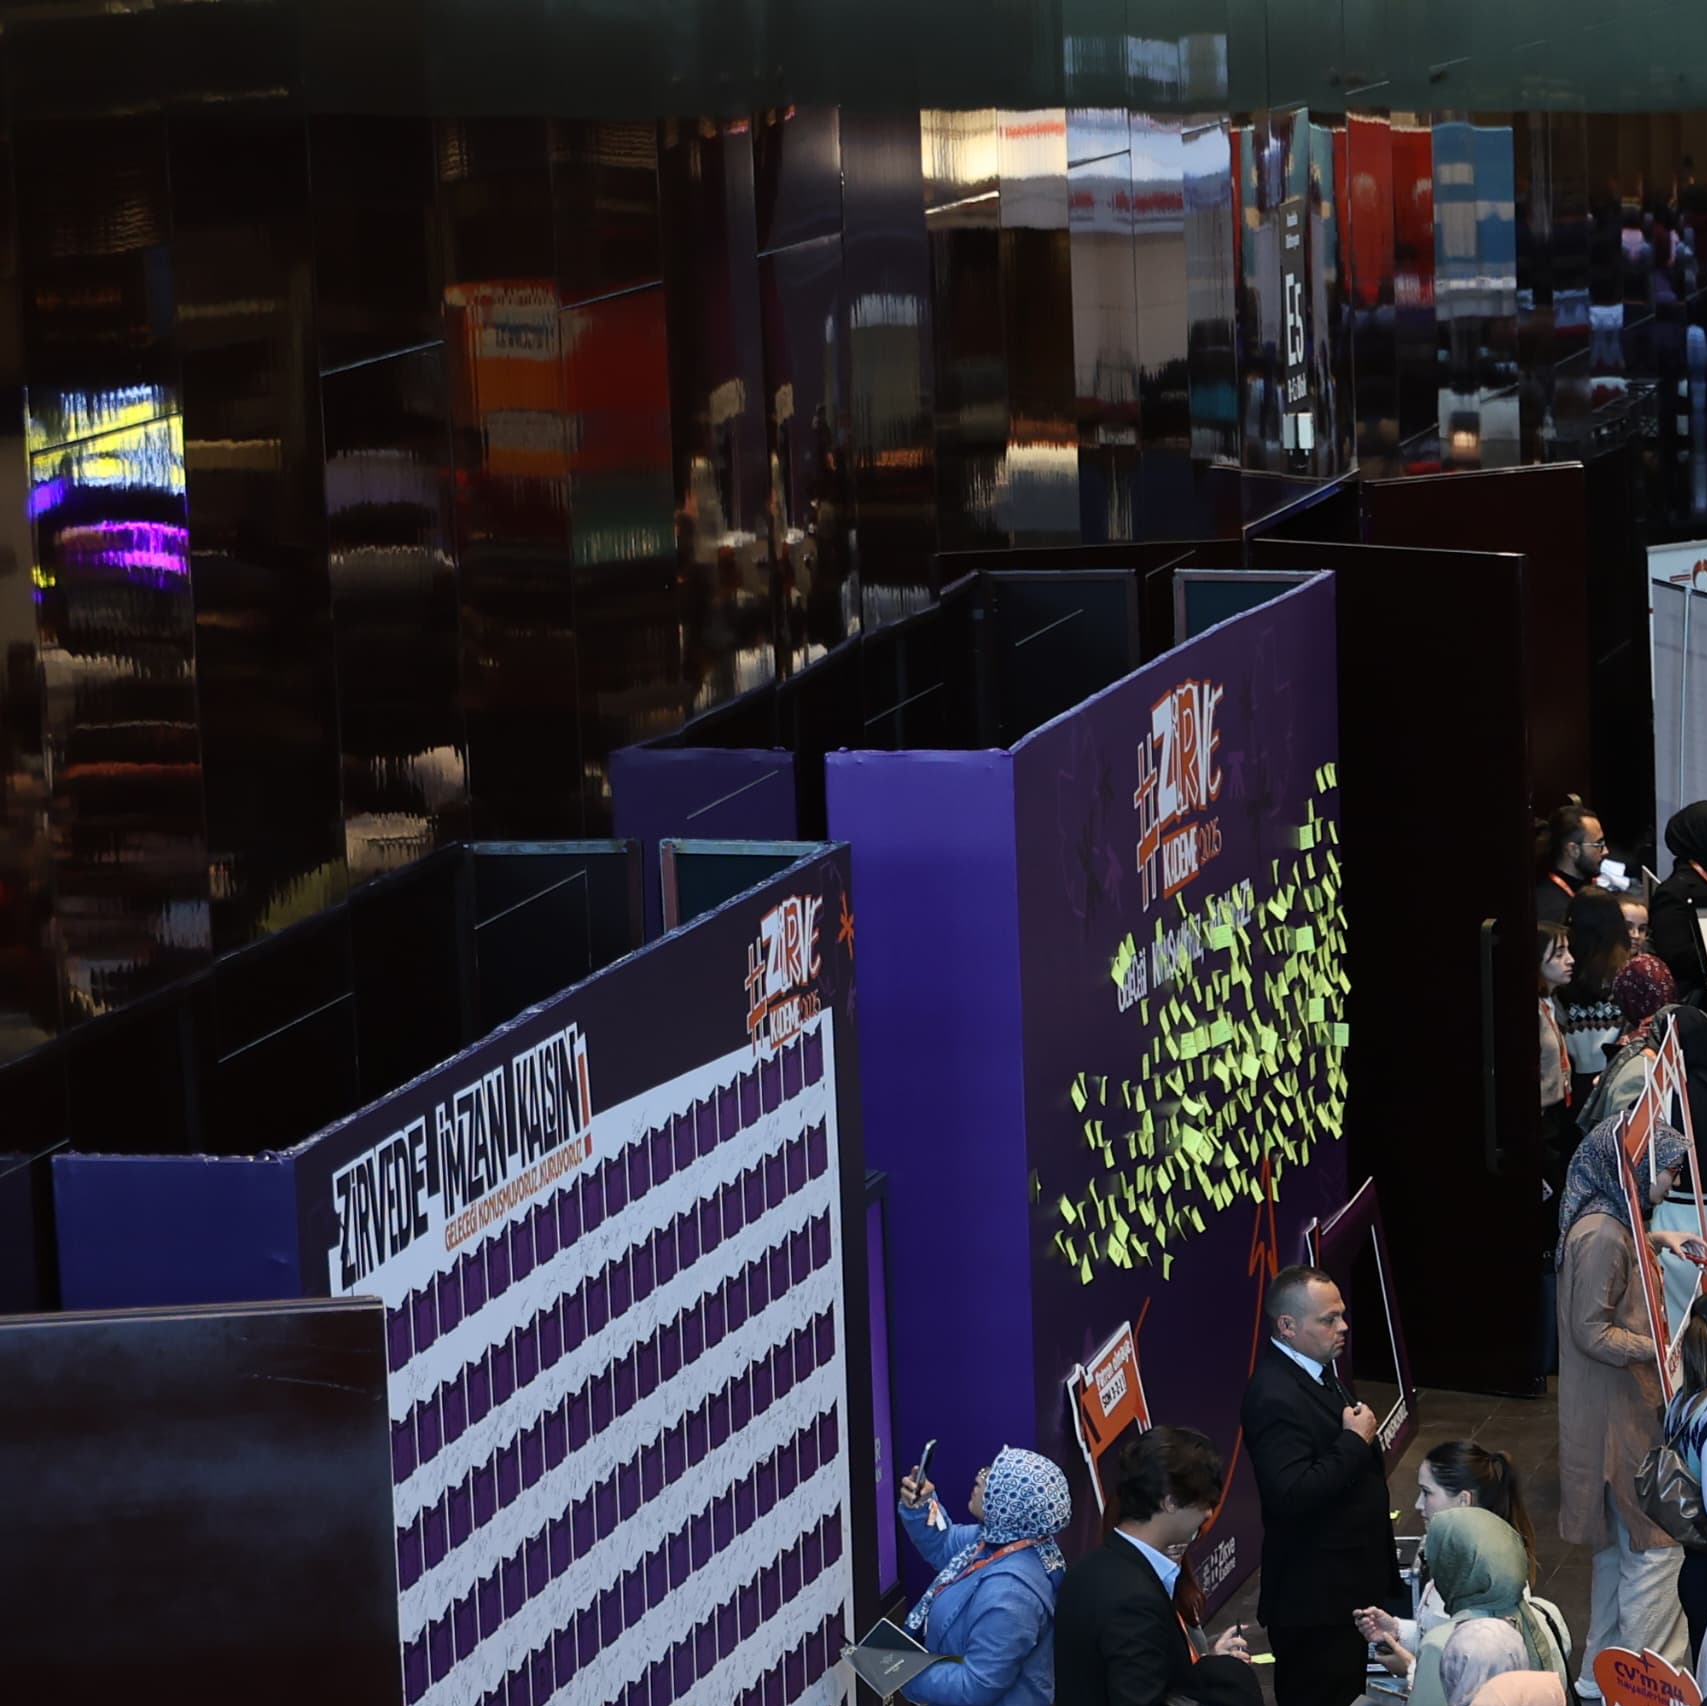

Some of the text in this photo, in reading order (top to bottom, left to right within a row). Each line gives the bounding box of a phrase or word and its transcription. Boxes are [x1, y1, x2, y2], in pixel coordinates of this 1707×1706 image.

[1285, 272, 1304, 367] E5
[336, 1027, 593, 1291] ZİRVEDE İMZAN KALSIN!
